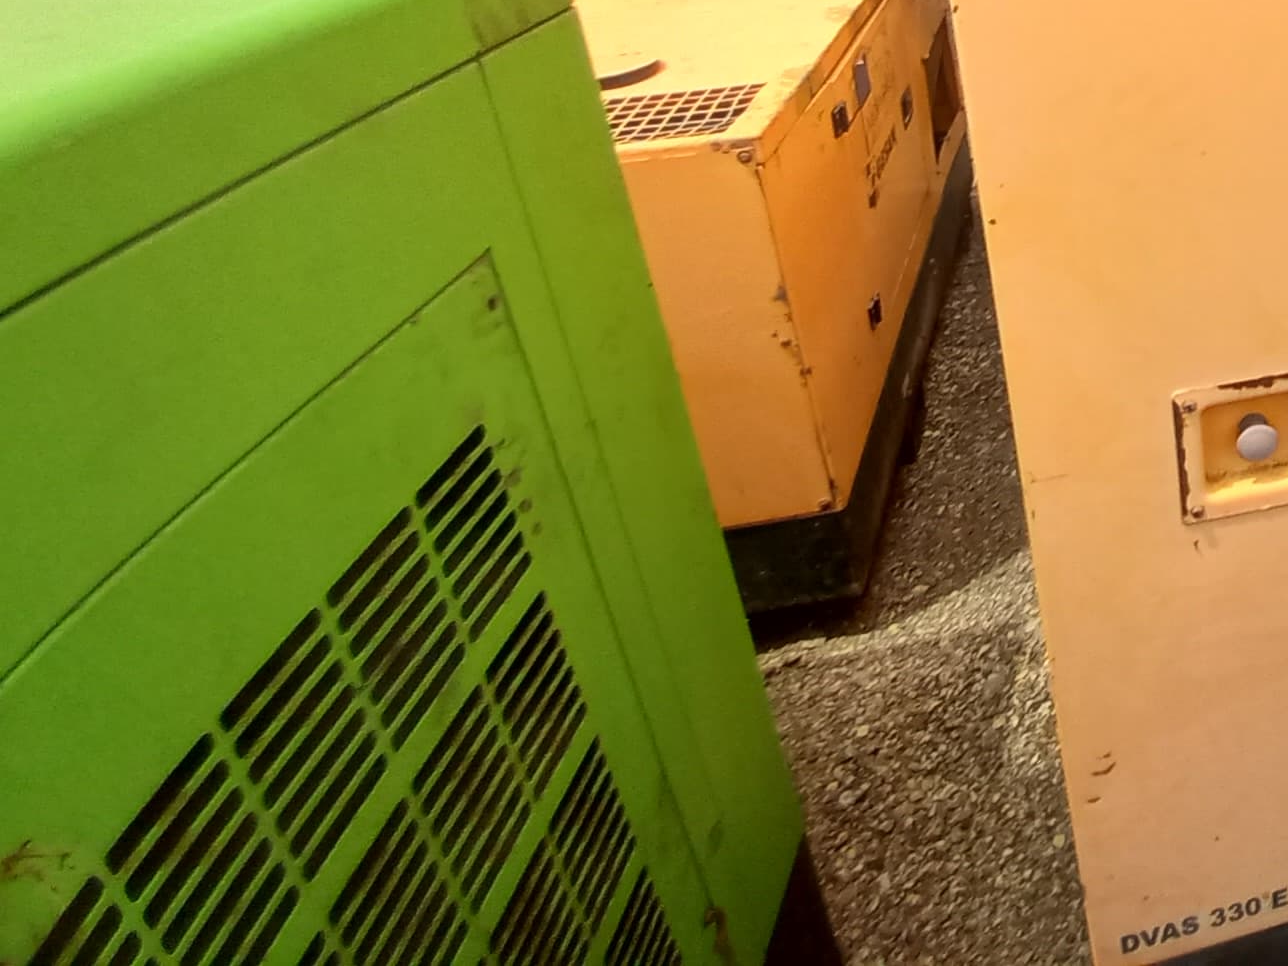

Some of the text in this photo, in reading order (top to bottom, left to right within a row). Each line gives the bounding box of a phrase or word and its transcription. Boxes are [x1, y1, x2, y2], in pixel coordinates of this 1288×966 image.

[1119, 887, 1288, 955] DVAS 330 E
